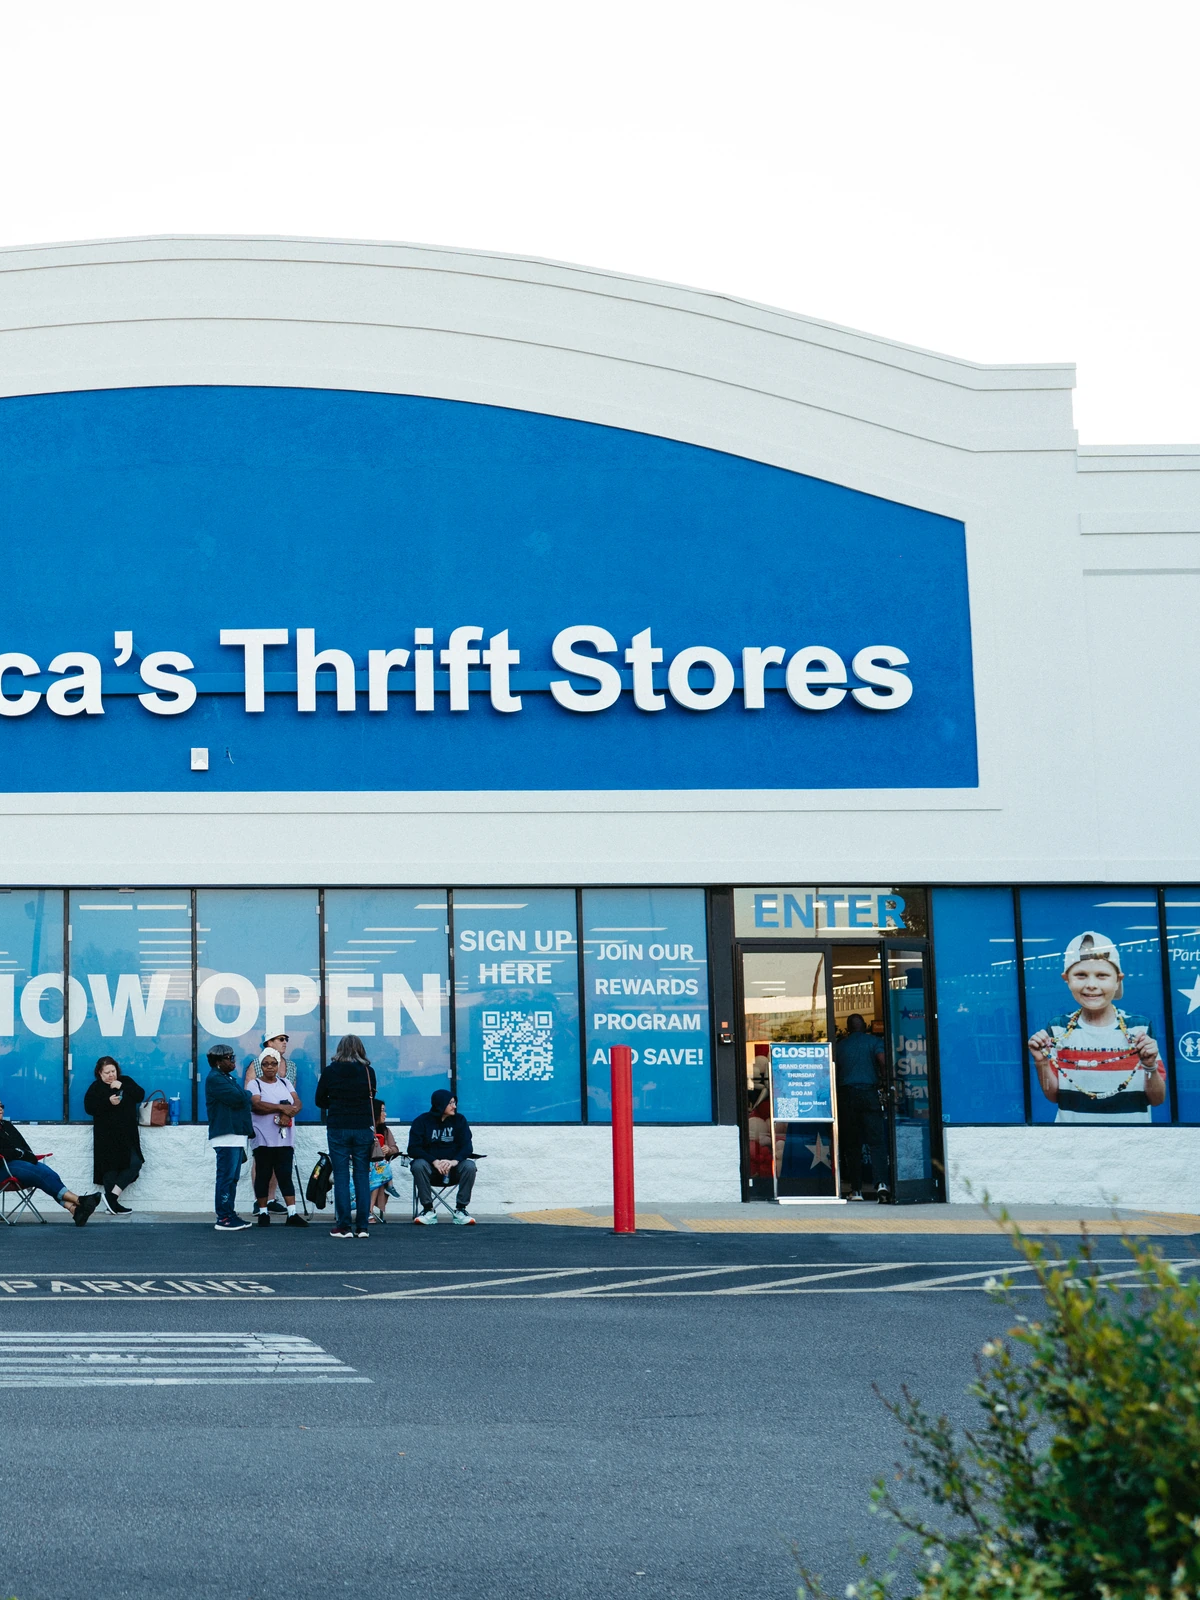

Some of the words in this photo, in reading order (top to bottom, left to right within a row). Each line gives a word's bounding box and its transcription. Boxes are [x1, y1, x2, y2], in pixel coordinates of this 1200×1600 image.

[220, 625, 525, 713] Thrift
[549, 624, 914, 712] Stores
[754, 893, 907, 929] ENTER
[459, 930, 526, 952] SIGN
[534, 930, 573, 951] UP
[597, 944, 643, 960] JOIN
[649, 944, 694, 960] OUR
[479, 963, 552, 985] HERE
[595, 978, 699, 995] REWARDS
[196, 972, 442, 1038] OPEN
[593, 1013, 701, 1030] PROGRAM
[592, 1048, 639, 1065] AD
[643, 1047, 704, 1065] SAVE!
[771, 1047, 829, 1058] CLOSED!
